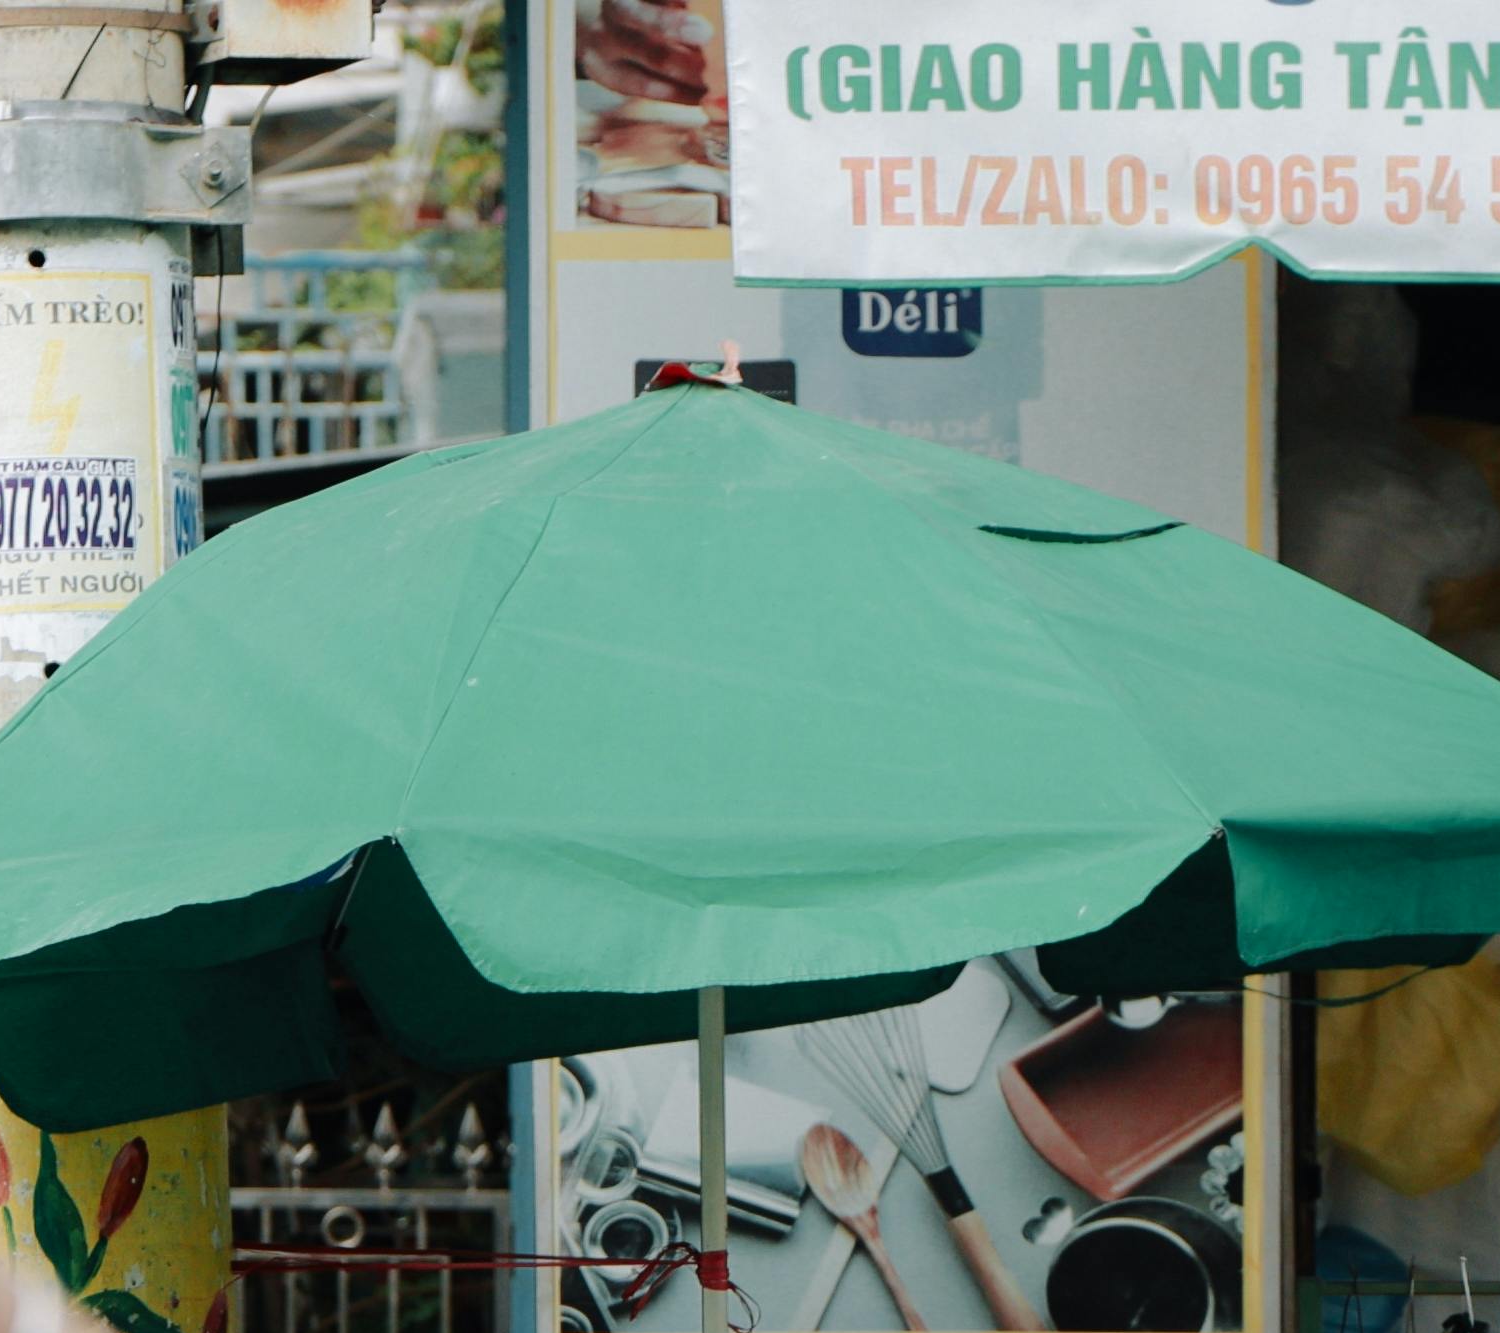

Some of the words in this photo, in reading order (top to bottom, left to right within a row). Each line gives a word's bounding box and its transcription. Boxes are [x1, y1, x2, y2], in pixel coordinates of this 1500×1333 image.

[785, 43, 1022, 121] (GIAO
[1057, 26, 1304, 112] HÀNG
[840, 153, 1169, 227] TEL/ZALO:
[1193, 153, 1360, 226] 0965
[1385, 154, 1466, 226] 54
[44, 293, 146, 327] TRÈO!
[857, 289, 960, 333] Déli
[60, 571, 144, 593] NGƯỜI
